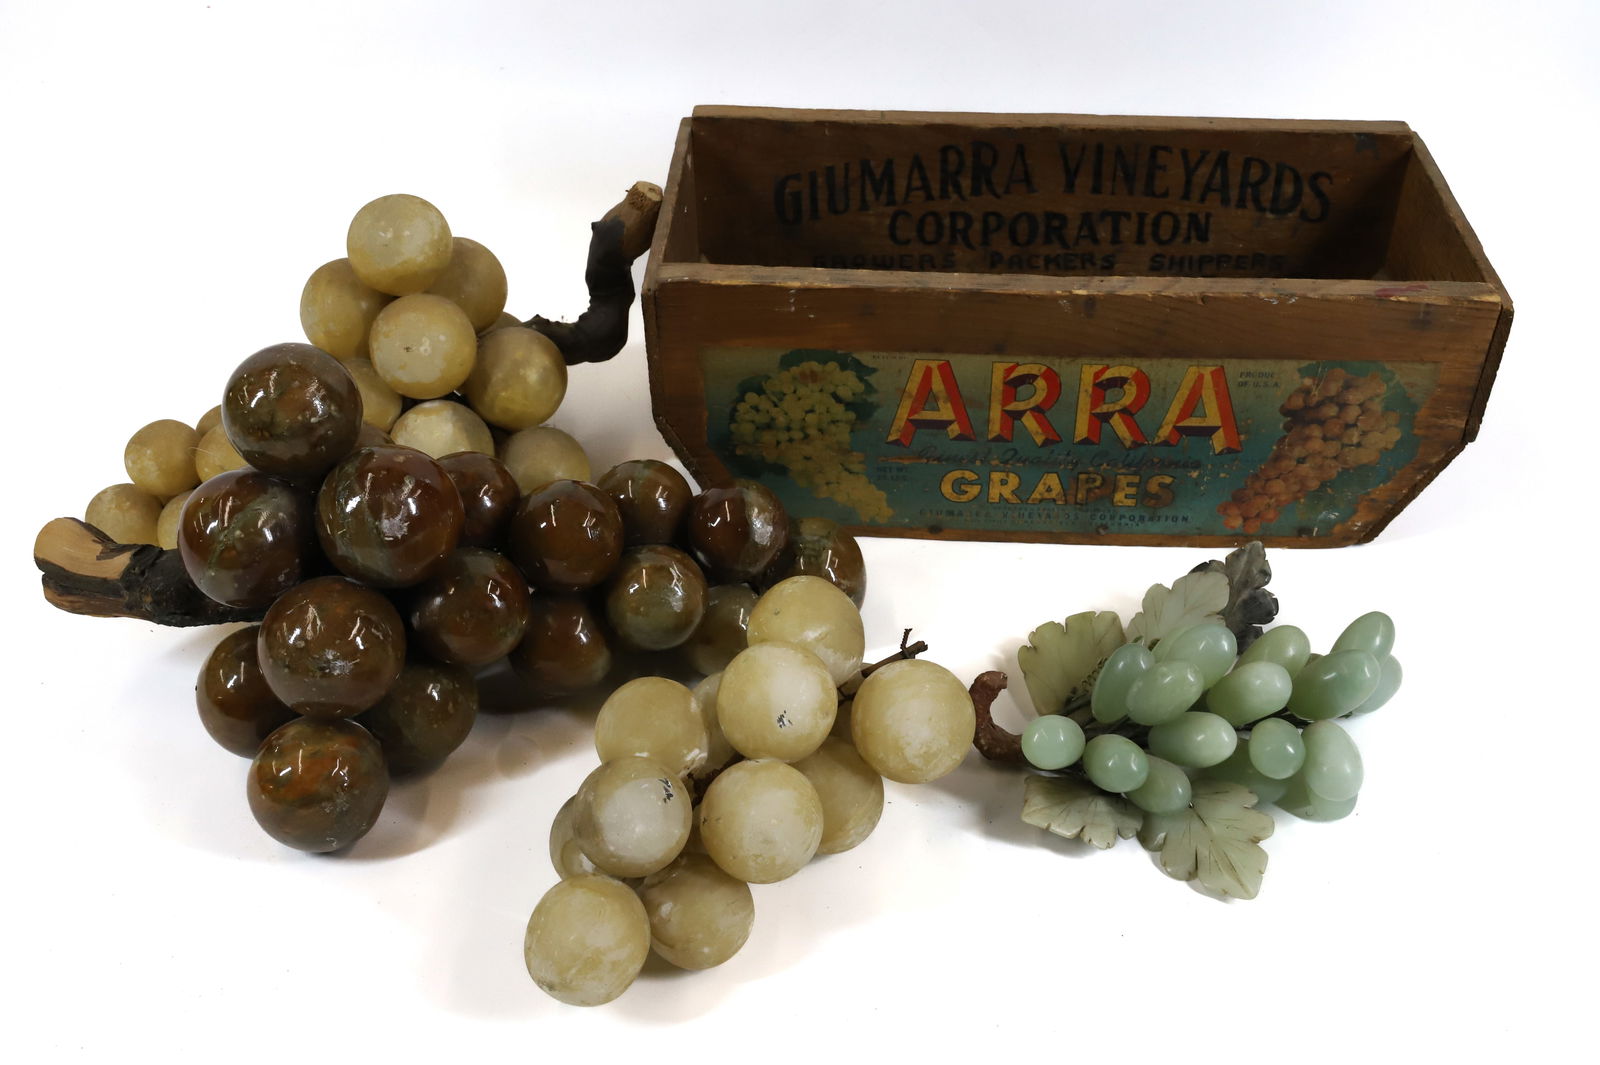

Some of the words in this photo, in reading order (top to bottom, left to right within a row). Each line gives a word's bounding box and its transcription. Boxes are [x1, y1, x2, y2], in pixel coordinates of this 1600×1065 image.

[774, 140, 1037, 227] GIUMARRA
[1059, 141, 1335, 223] VINEYARDS
[888, 209, 1214, 249] CORPORATION
[988, 250, 1117, 271] PACKERS
[1149, 251, 1288, 273] SHIPPERS
[885, 361, 1242, 455] ARRA
[940, 470, 1175, 507] GRAPES
[1089, 512, 1191, 523] CORPORATION
